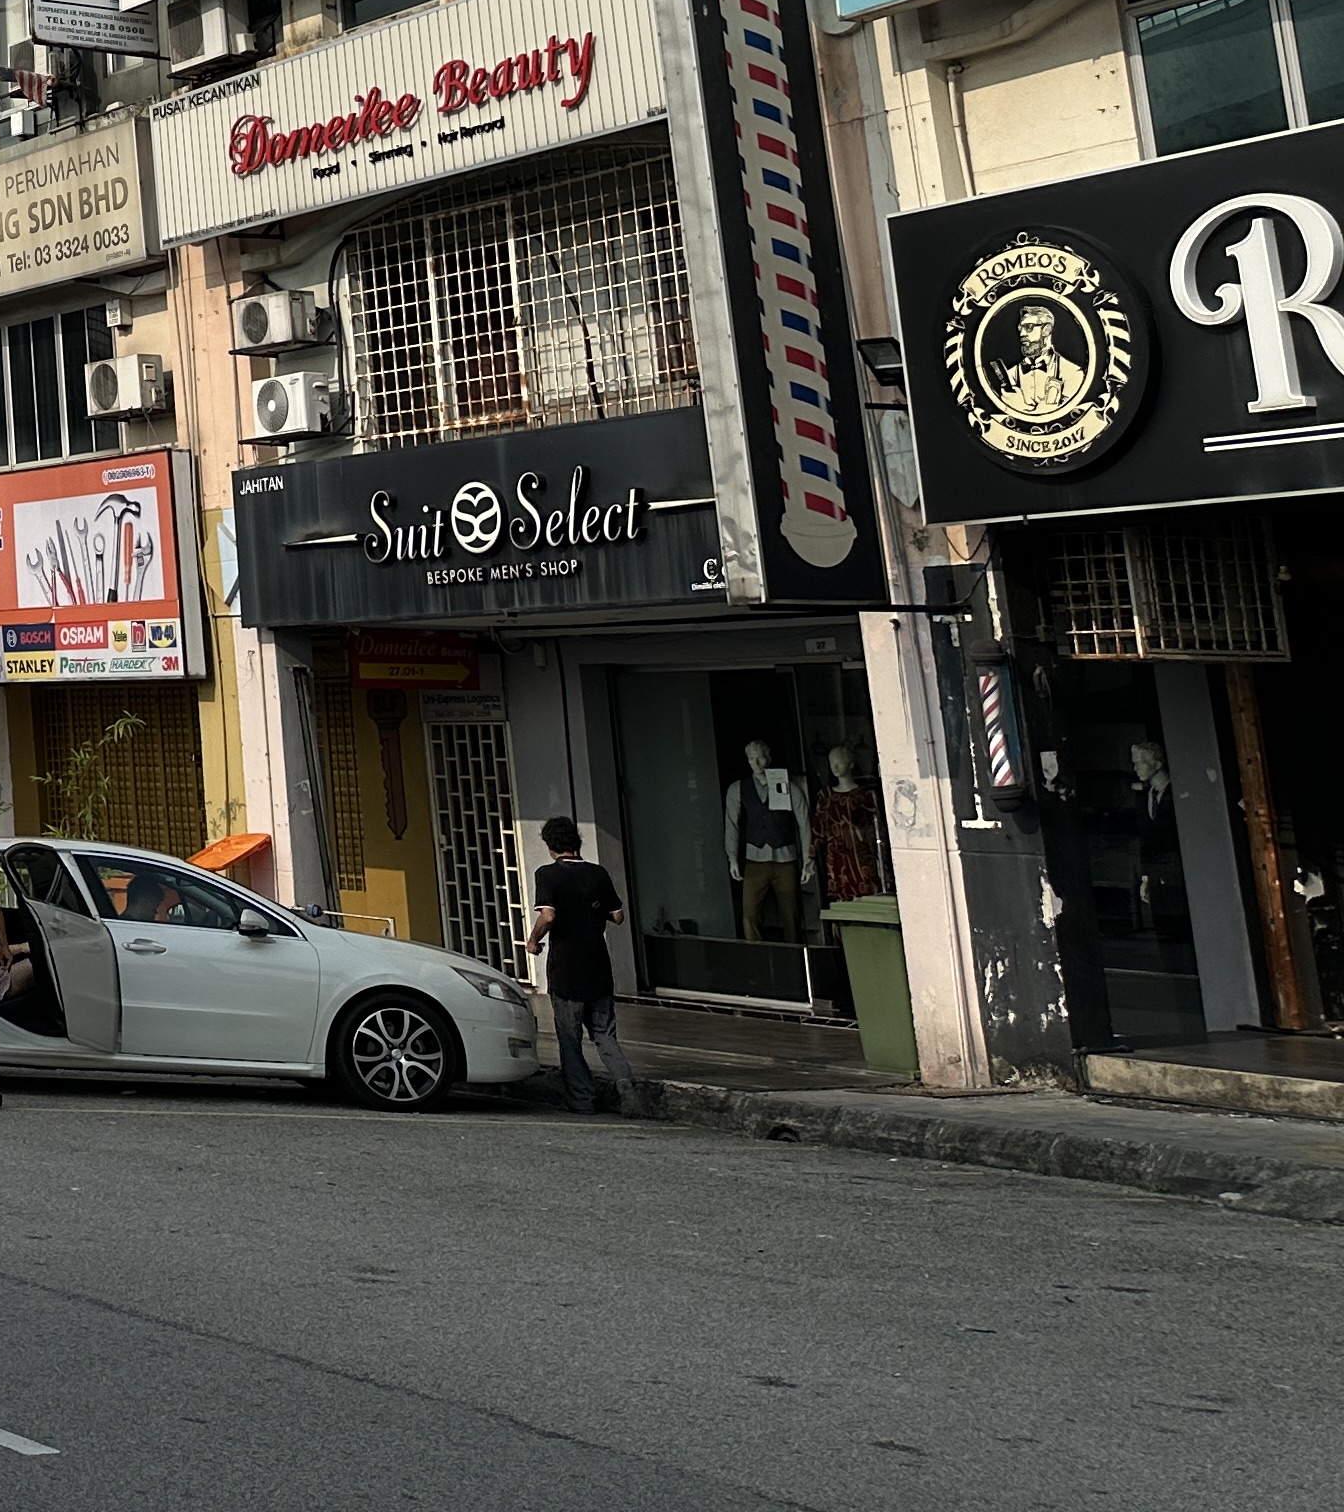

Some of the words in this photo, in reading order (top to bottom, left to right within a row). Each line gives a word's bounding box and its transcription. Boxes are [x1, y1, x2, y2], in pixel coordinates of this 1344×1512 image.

[152, 96, 187, 122] PUSAT
[187, 73, 262, 110] KECANTIKAN
[229, 85, 421, 178] Domeilee
[433, 30, 597, 114] Beauty
[460, 115, 506, 142] Removal
[5, 141, 120, 199] PERUMAHAN
[27, 191, 74, 234] SDN
[78, 175, 130, 220] BHD
[6, 251, 32, 274] Tel:
[34, 245, 52, 267] 03
[55, 236, 90, 262] 3324
[93, 222, 130, 251] 0033
[975, 250, 1068, 292] ROMEO'S
[1005, 433, 1052, 455] SINCE
[1051, 425, 1087, 453] 2017
[238, 474, 285, 497] JAHITAN
[362, 488, 447, 566] Suit
[508, 463, 648, 552] Select
[425, 565, 485, 586] BESPOKE
[489, 561, 535, 581] MEN'S
[538, 557, 580, 577] SHOP
[19, 629, 52, 644] BOSCH
[59, 625, 105, 645] OSRAM
[6, 658, 55, 674] STANLEY
[59, 655, 107, 674] Pentens
[161, 655, 180, 672] 3M
